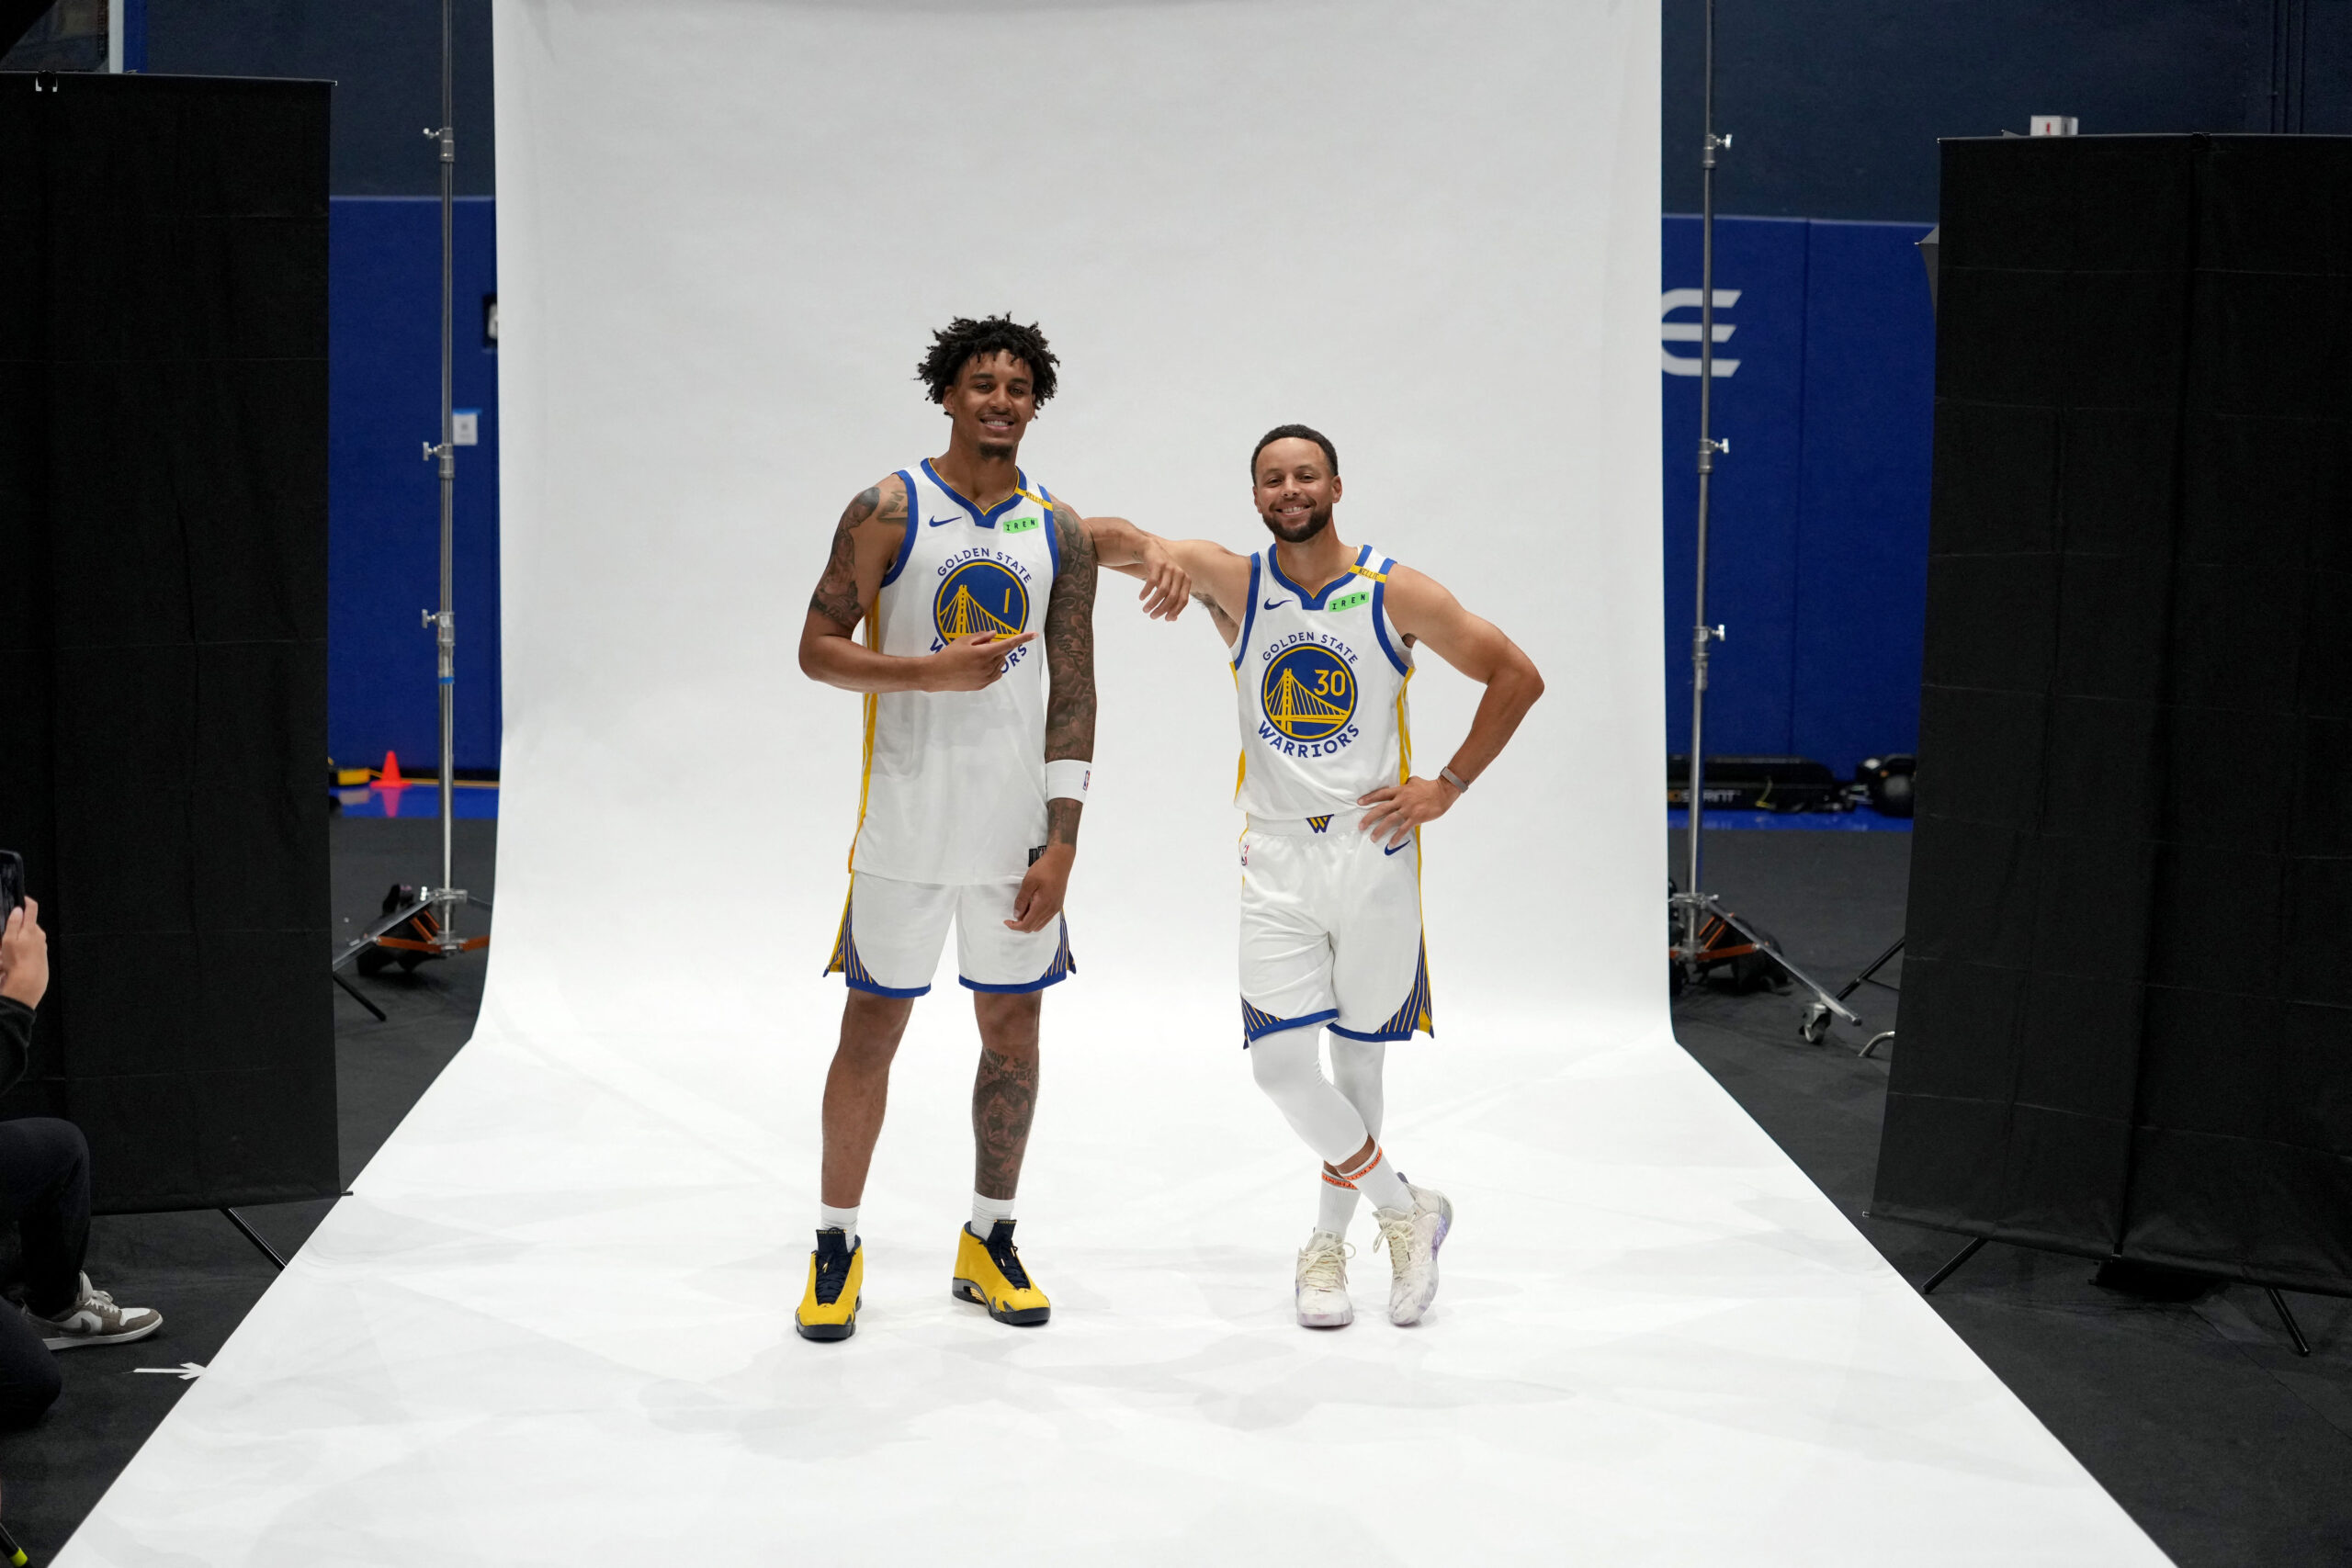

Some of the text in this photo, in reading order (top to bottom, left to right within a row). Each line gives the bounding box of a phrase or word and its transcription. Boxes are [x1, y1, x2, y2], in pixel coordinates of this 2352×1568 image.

[1005, 519, 1035, 532] IREN
[937, 547, 1032, 584] GOLDEN STATE
[1359, 567, 1380, 581] NELLIE
[1003, 588, 1011, 614] 1
[1332, 593, 1366, 610] IREN
[1262, 631, 1359, 665] GOLDEN STATE
[1314, 669, 1346, 697] 30
[1258, 720, 1360, 759] WARRIORS
